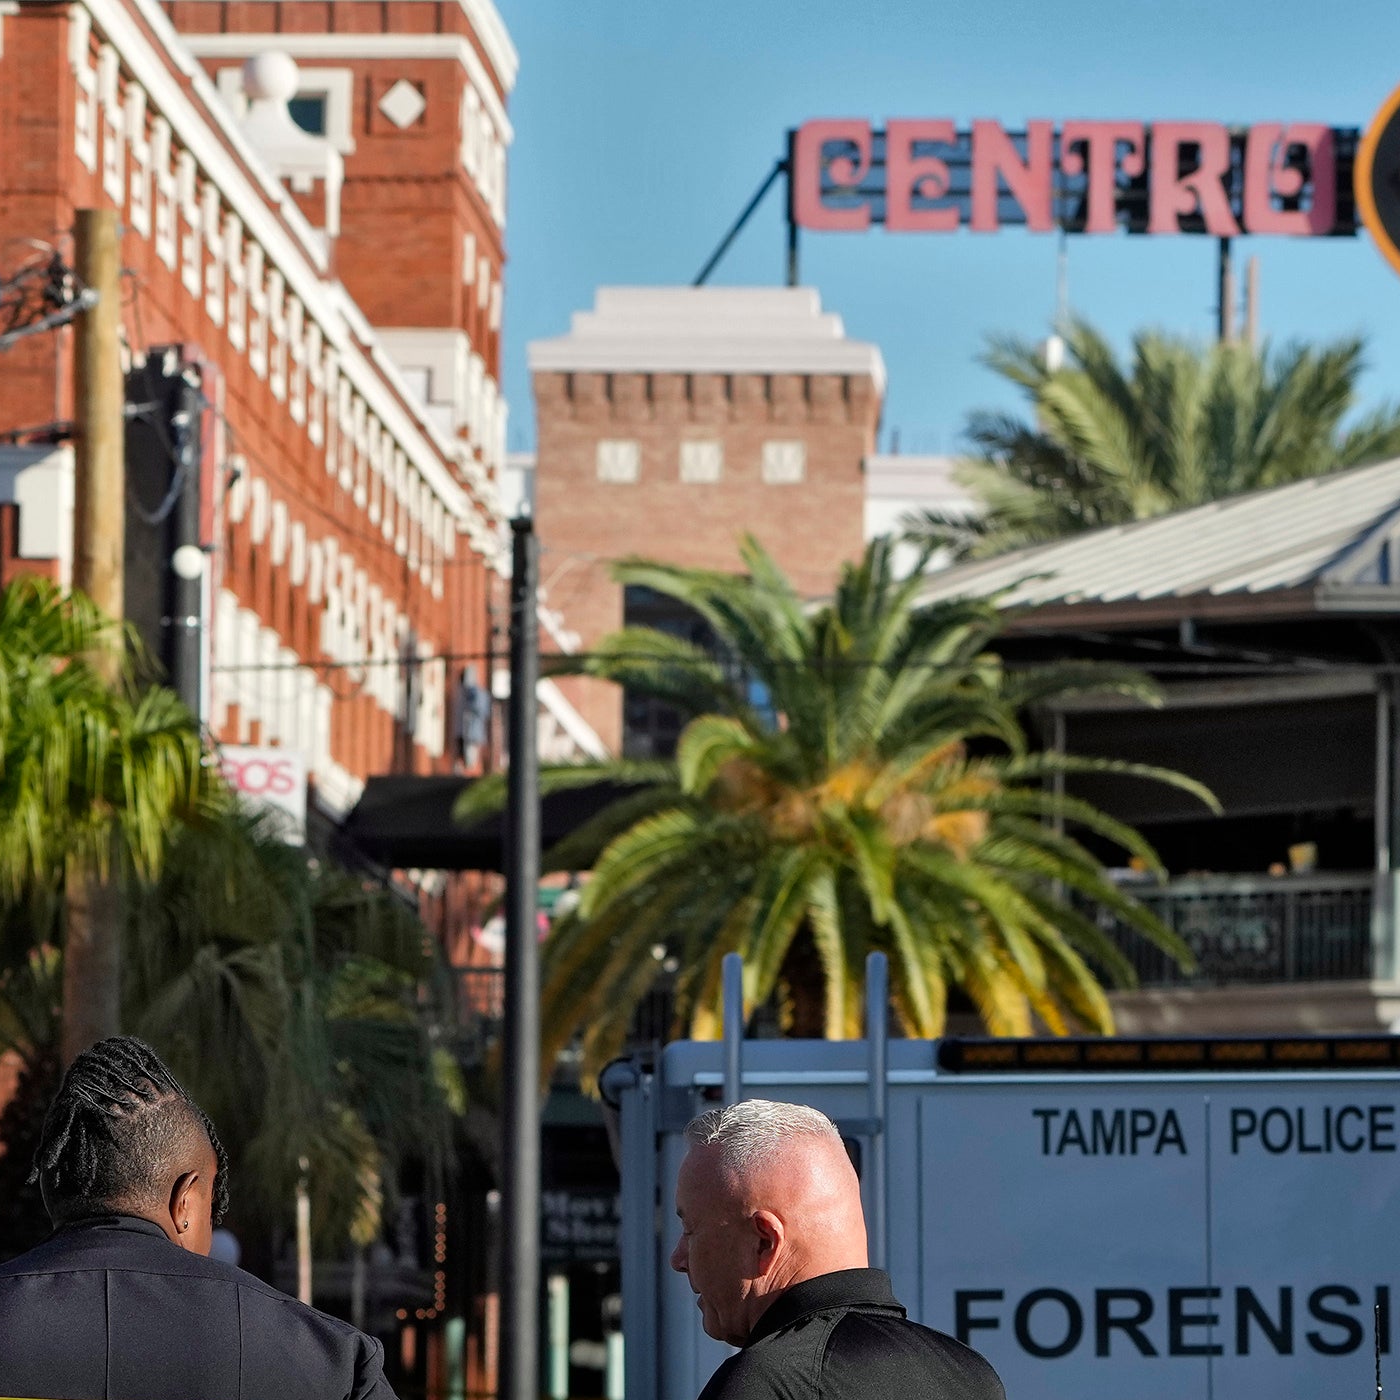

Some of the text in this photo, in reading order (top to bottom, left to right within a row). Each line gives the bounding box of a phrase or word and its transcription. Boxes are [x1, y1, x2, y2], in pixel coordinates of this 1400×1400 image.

[794, 119, 1335, 235] CENTRO
[1033, 1105, 1397, 1156] TAMPA POLICE
